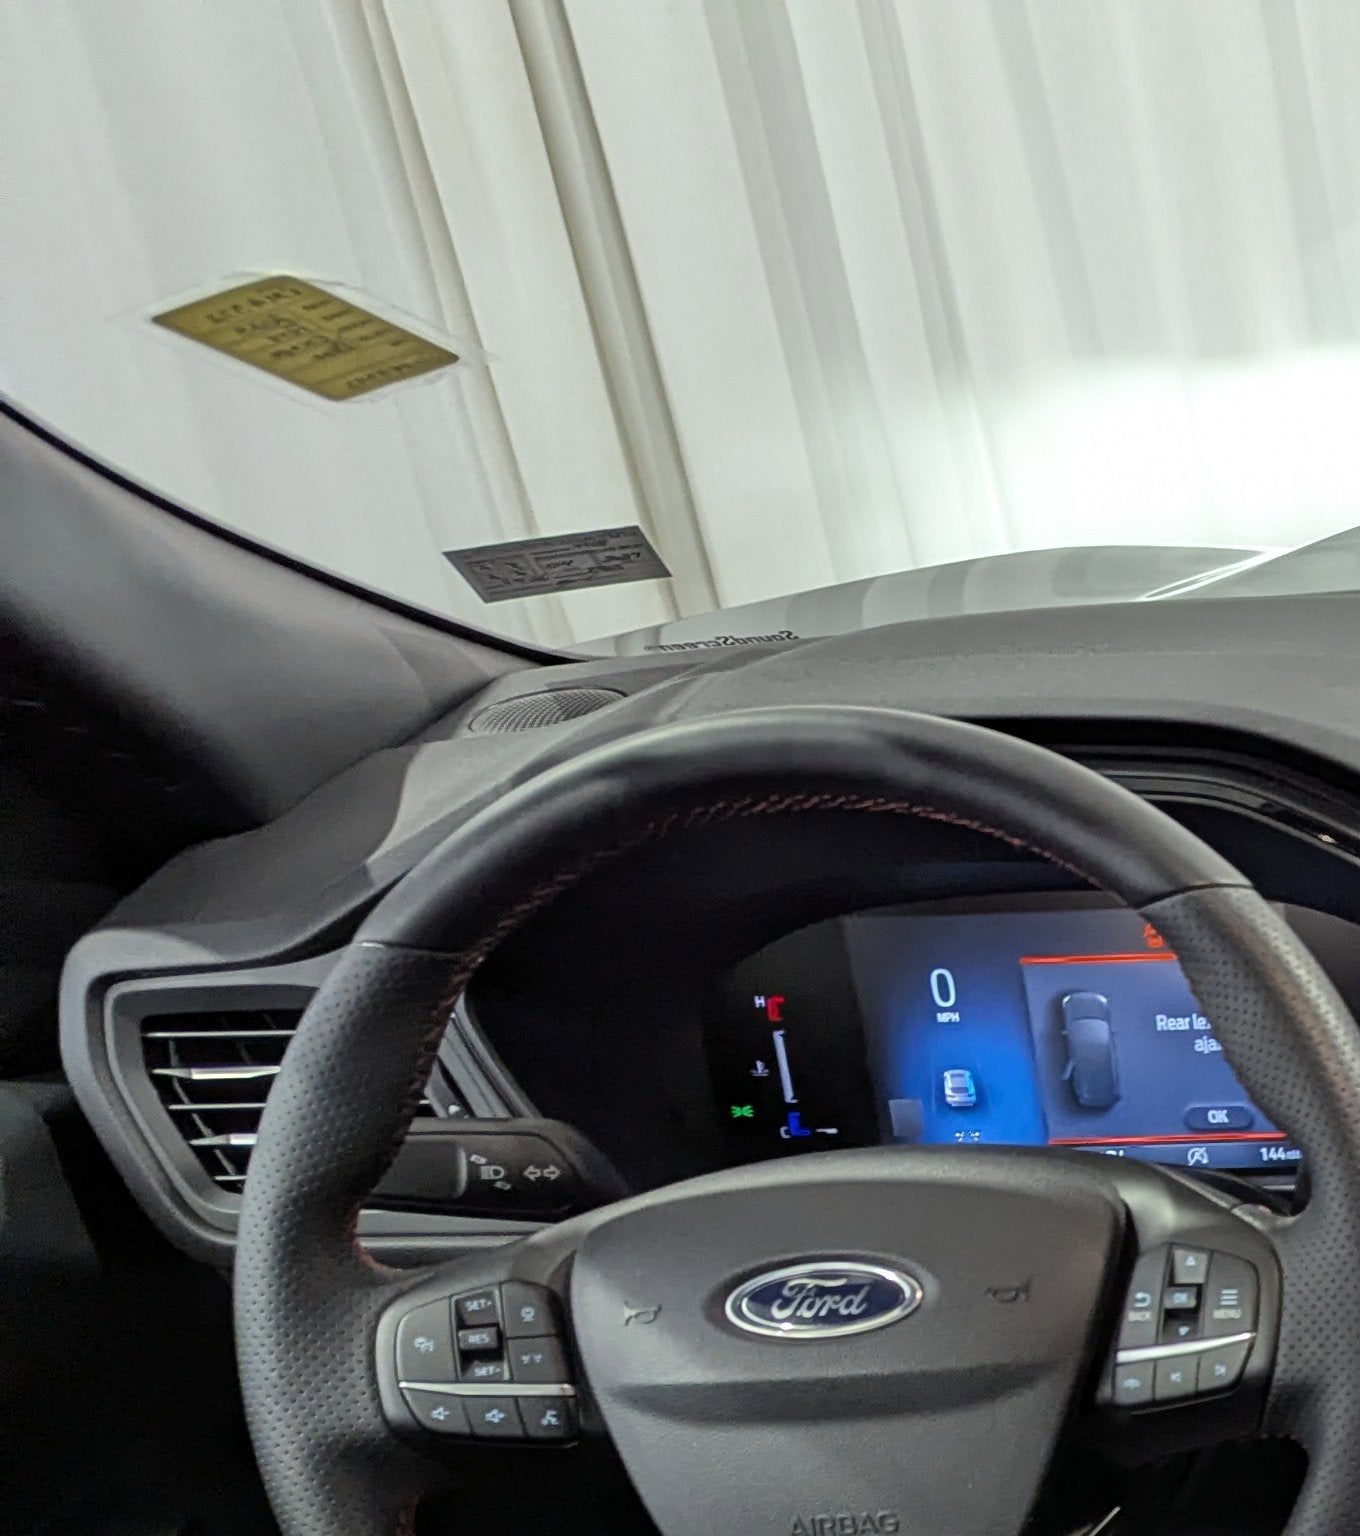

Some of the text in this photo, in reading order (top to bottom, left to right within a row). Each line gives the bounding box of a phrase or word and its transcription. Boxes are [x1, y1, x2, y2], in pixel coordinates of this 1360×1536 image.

[930, 968, 957, 1008] 0
[753, 995, 766, 1008] H
[936, 1011, 960, 1023] MPH
[1155, 1014, 1190, 1031] Rear
[1194, 1035, 1223, 1054] aja
[1207, 1109, 1229, 1124] OK
[771, 1278, 871, 1319] Ford
